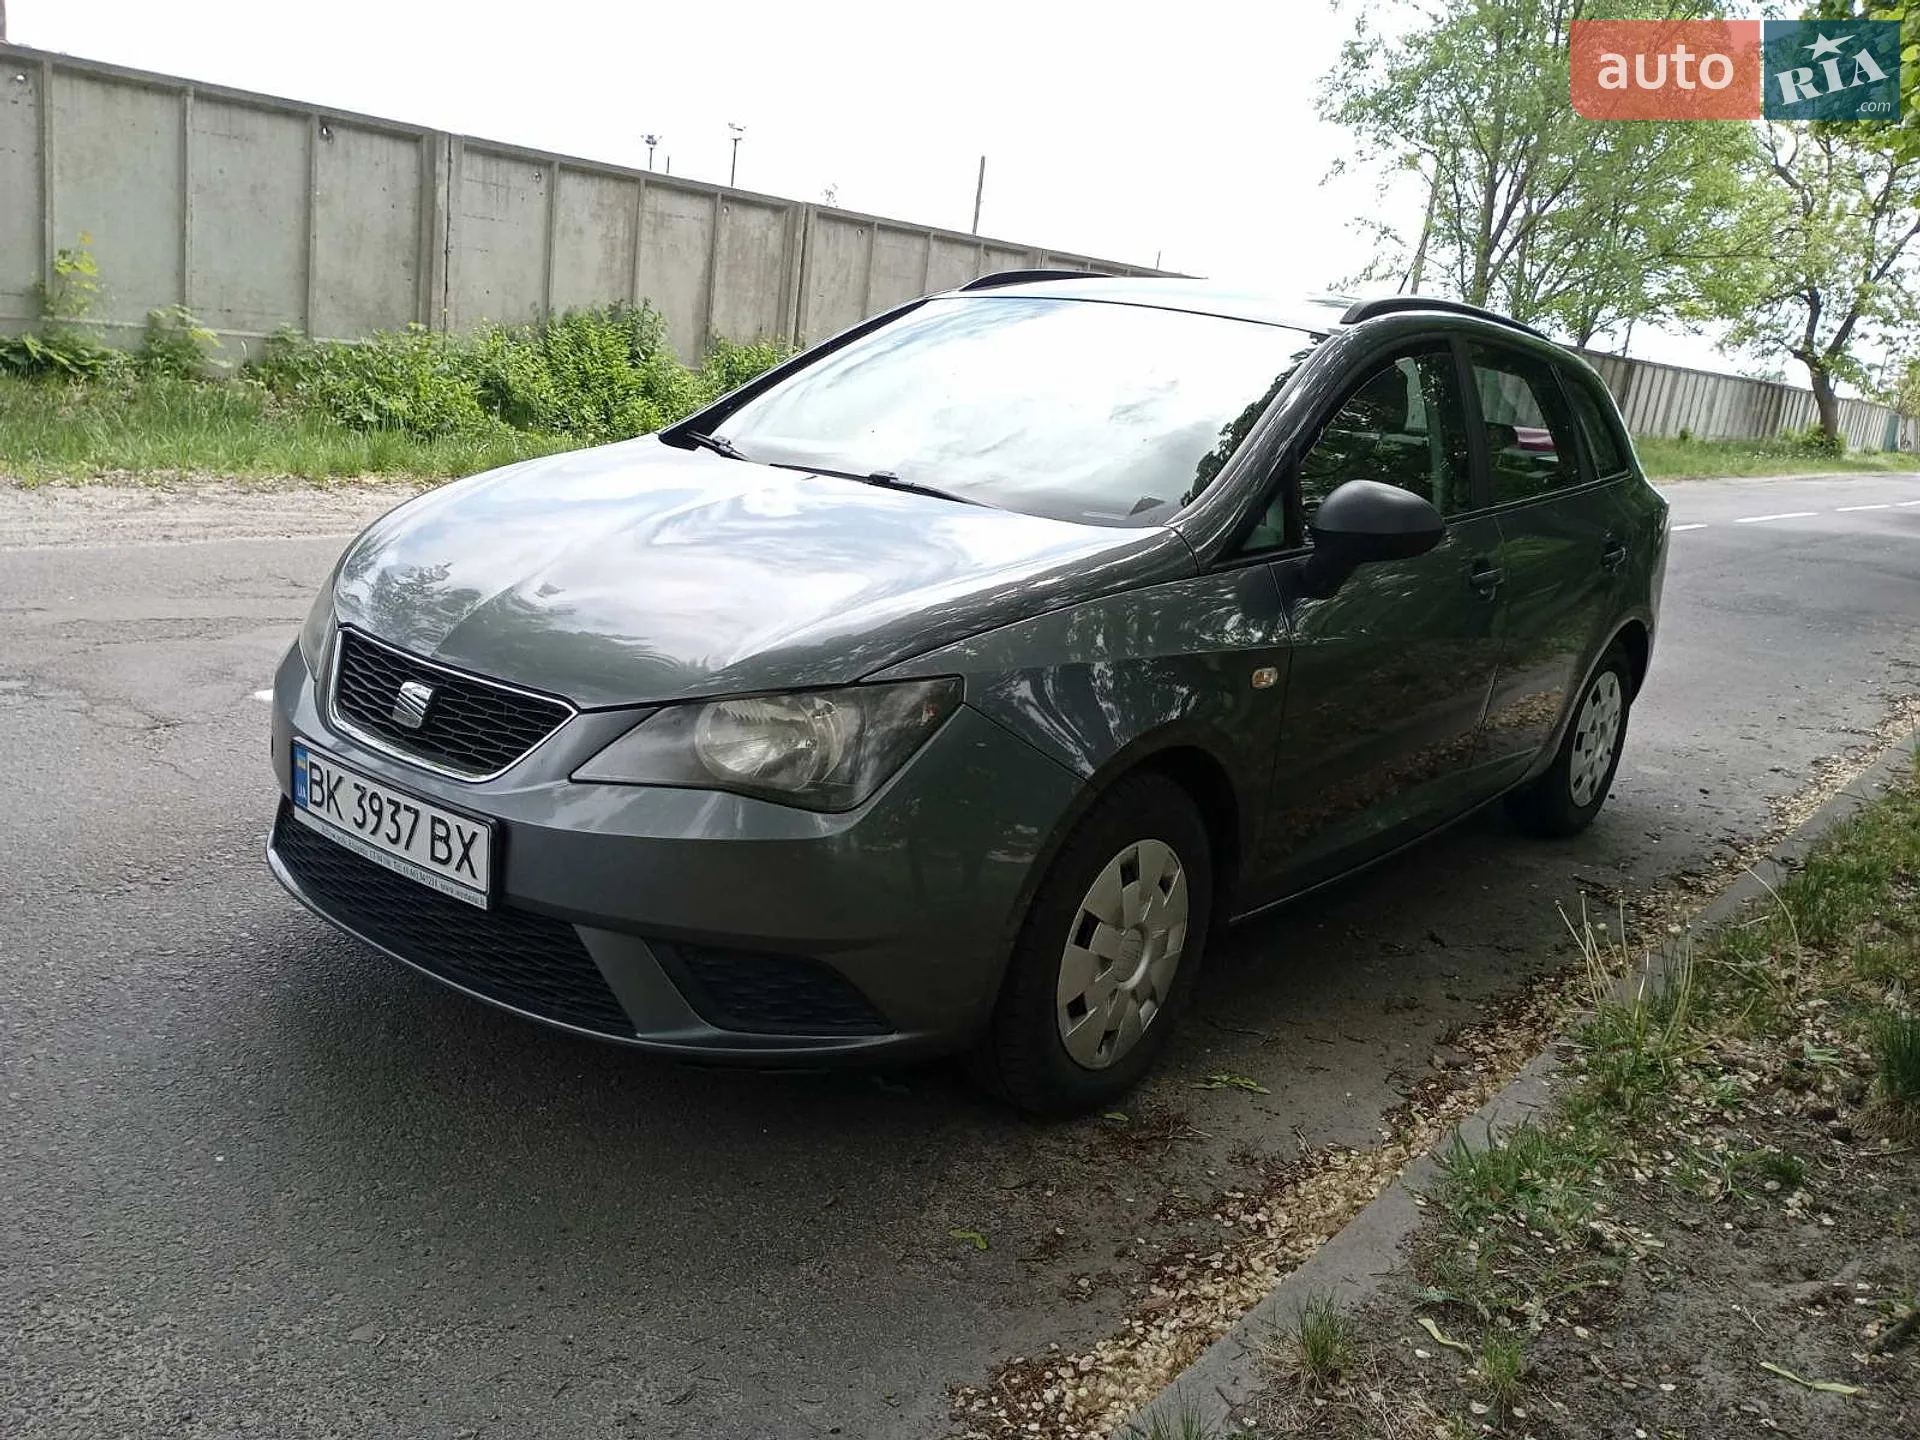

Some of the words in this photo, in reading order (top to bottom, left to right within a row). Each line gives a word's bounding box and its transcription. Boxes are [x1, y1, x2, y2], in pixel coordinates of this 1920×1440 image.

[308, 761, 345, 822] BK
[352, 782, 422, 852] 3937
[429, 814, 479, 879] BX
